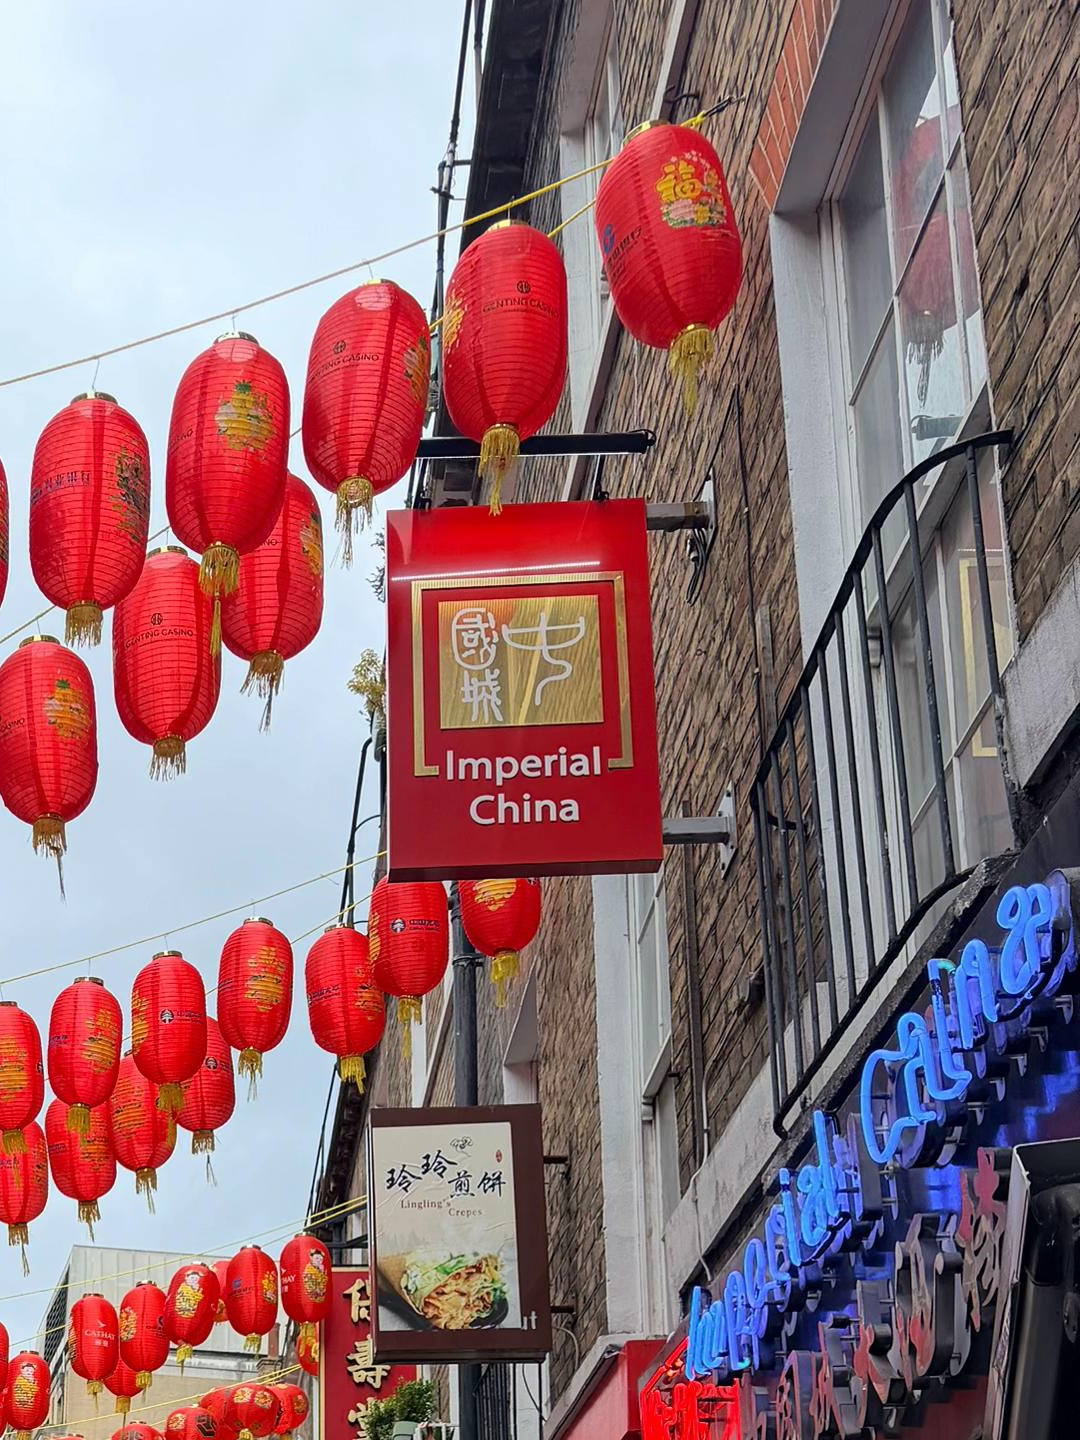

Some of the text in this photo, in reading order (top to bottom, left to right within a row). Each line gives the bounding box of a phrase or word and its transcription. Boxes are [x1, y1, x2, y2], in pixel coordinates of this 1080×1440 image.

[342, 353, 380, 365] CASINO
[125, 628, 194, 649] GENTING CASINO
[446, 746, 602, 787] Imperial
[470, 793, 580, 825] China
[400, 1199, 451, 1210] Lingling's
[448, 1207, 483, 1218] Crepes
